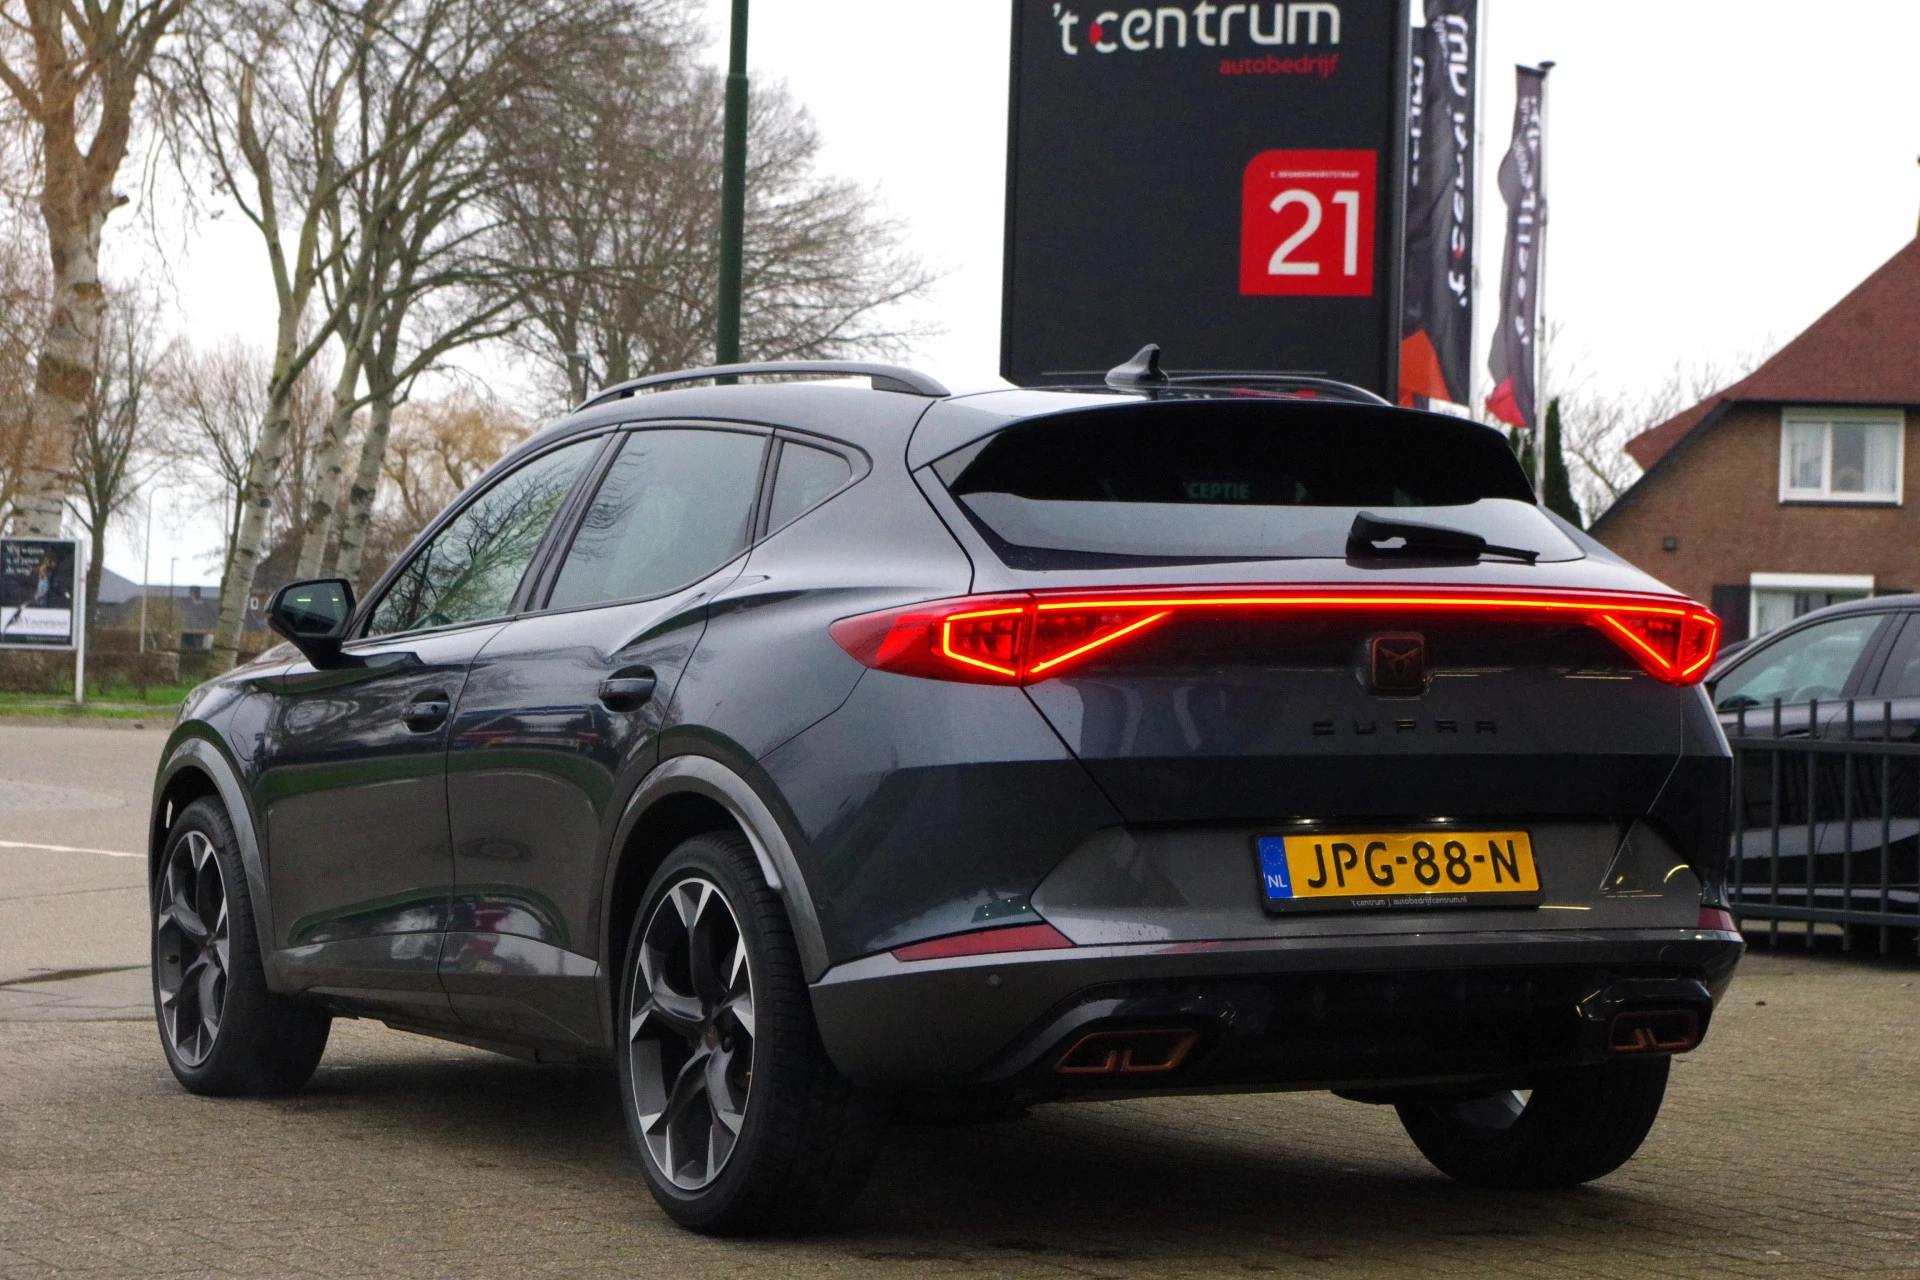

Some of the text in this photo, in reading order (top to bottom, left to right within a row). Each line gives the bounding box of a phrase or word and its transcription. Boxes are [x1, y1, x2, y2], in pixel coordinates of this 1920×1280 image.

[1053, 3, 1340, 55] 't centrum
[1219, 54, 1339, 78] autobedrijf
[1268, 189, 1360, 276] 21
[1313, 719, 1497, 735] CUPRA
[1308, 840, 1521, 888] JPG-88-N
[1268, 874, 1287, 889] NL
[1357, 898, 1386, 907] centrum
